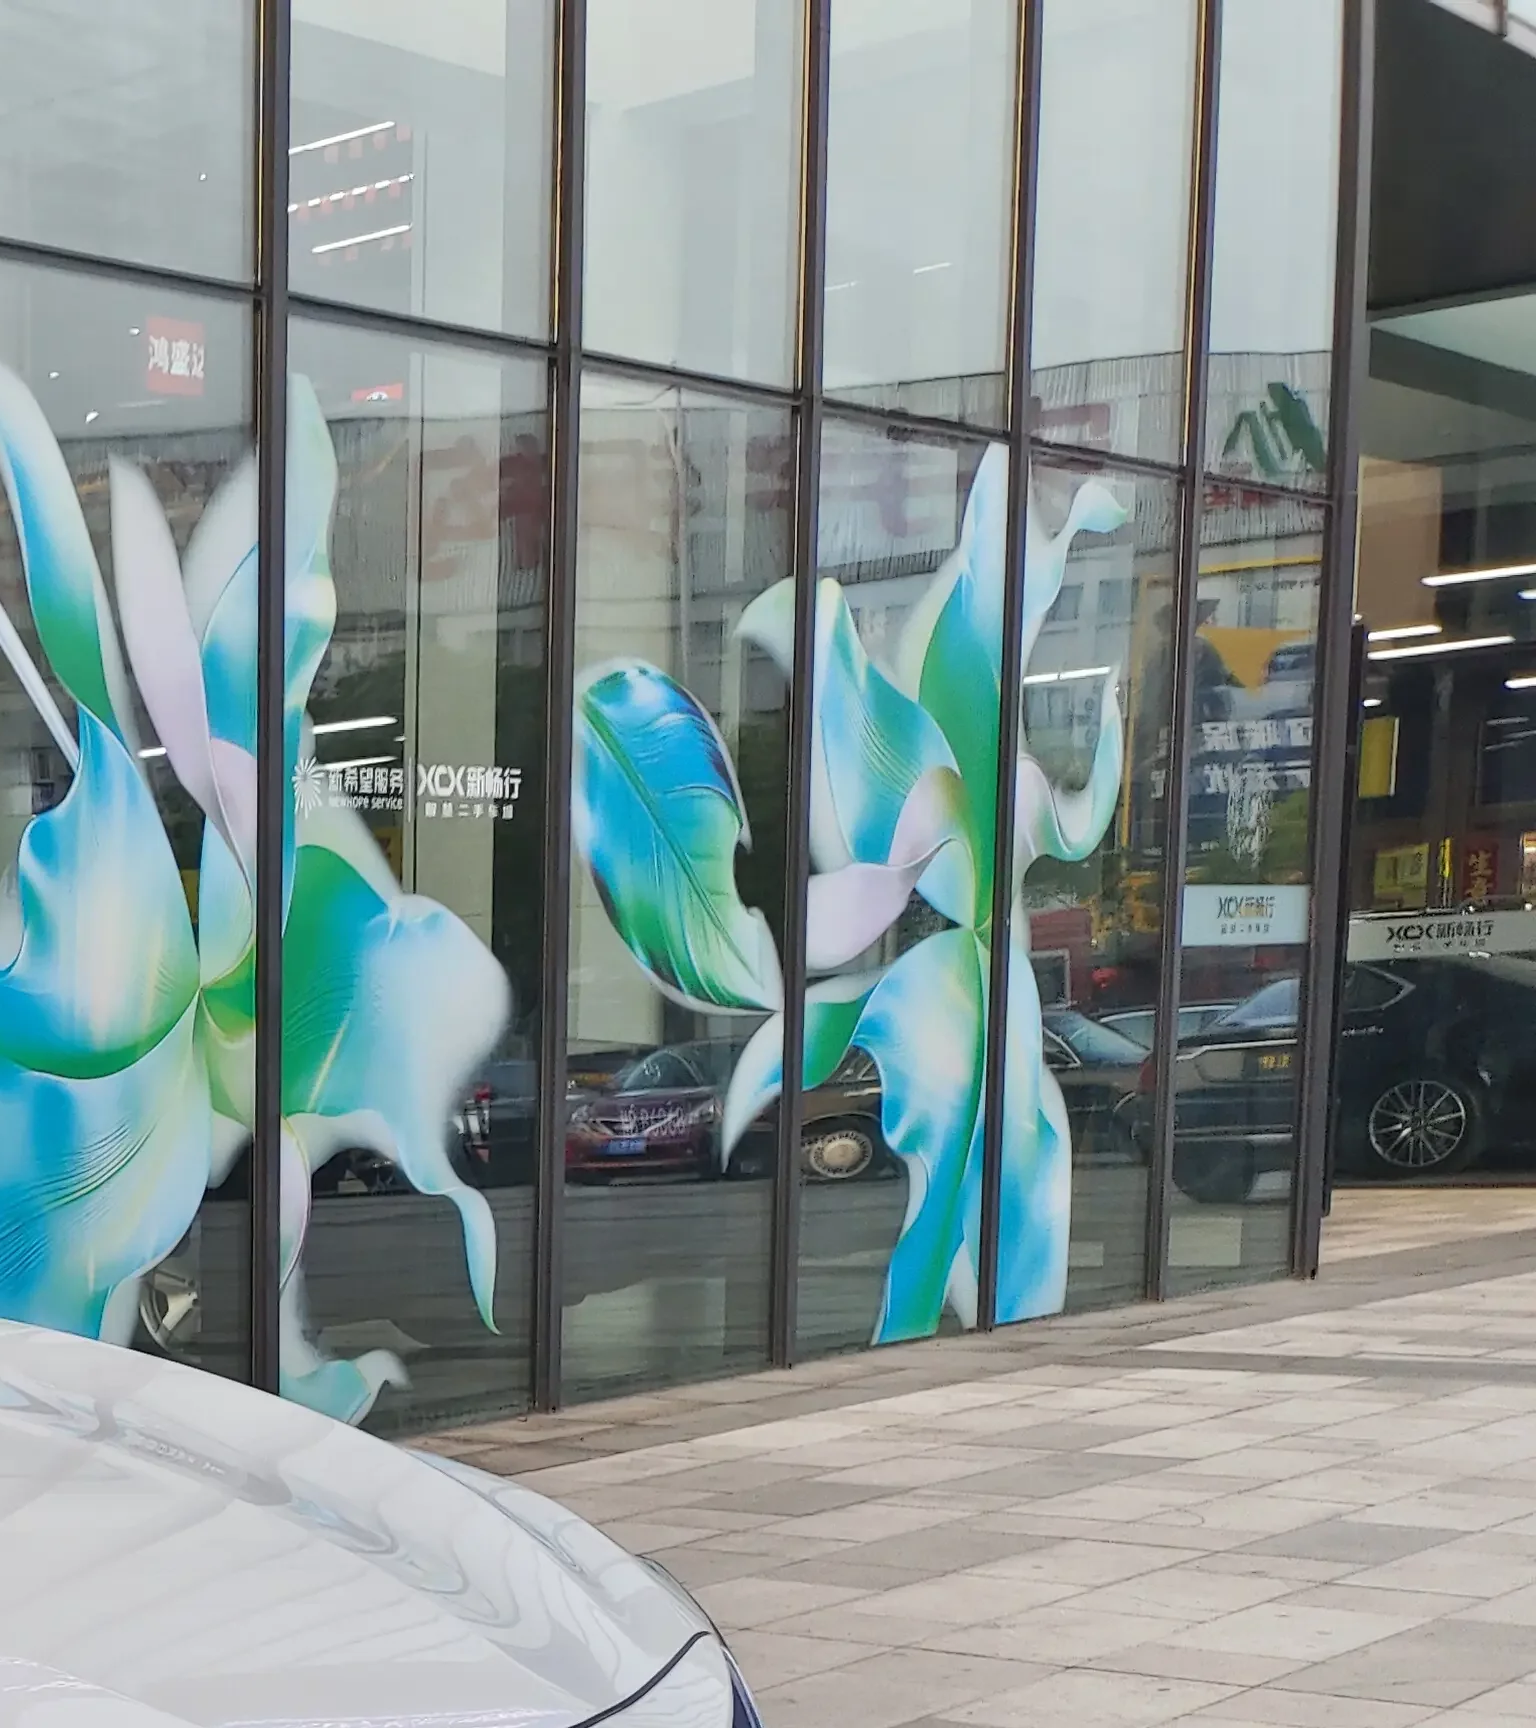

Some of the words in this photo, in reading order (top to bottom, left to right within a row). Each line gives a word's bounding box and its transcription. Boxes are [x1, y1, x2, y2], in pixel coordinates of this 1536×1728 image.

[328, 766, 404, 795] 新希望服务
